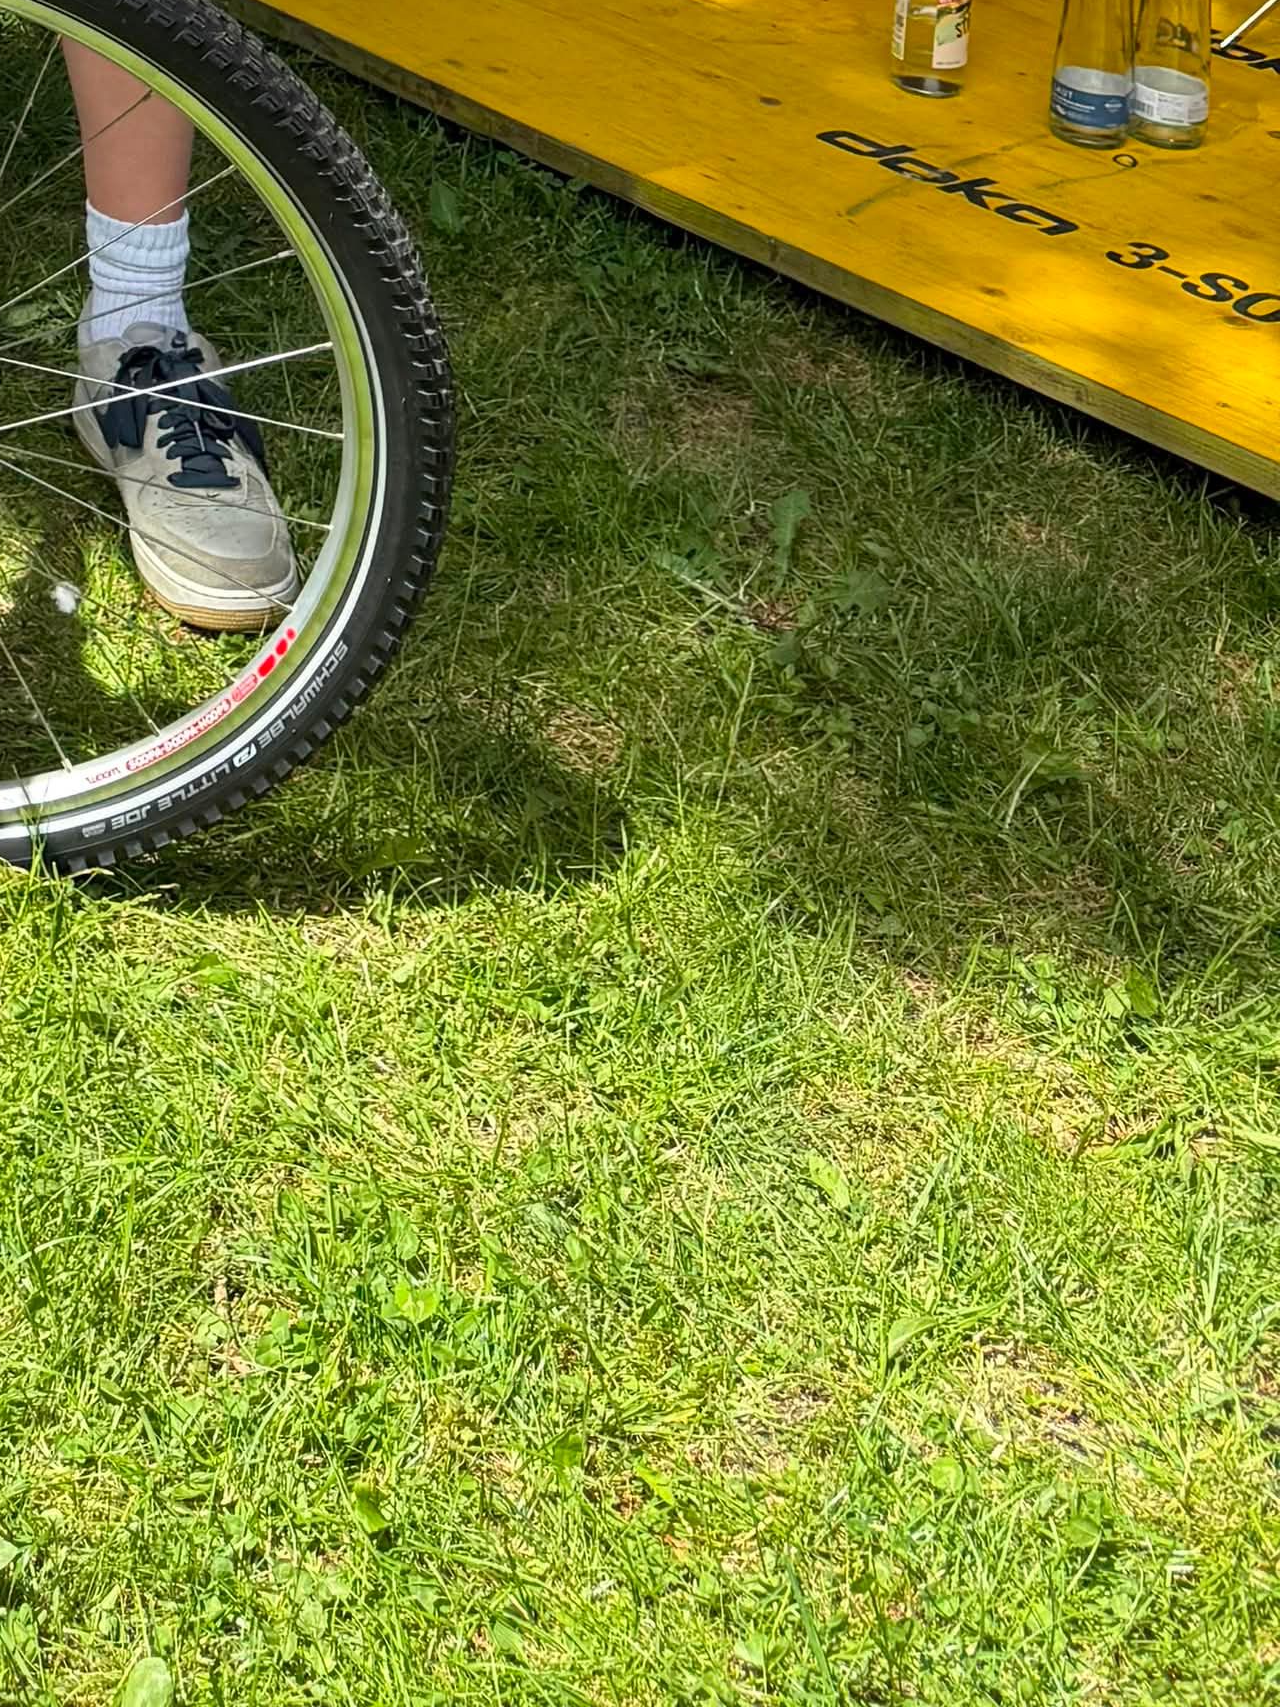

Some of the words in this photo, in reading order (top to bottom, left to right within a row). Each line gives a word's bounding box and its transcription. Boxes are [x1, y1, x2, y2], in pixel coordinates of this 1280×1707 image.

[815, 129, 1080, 236] doka
[259, 638, 350, 750] SCHWALBE
[111, 807, 153, 830] JOE
[158, 760, 240, 812] LITTLE
